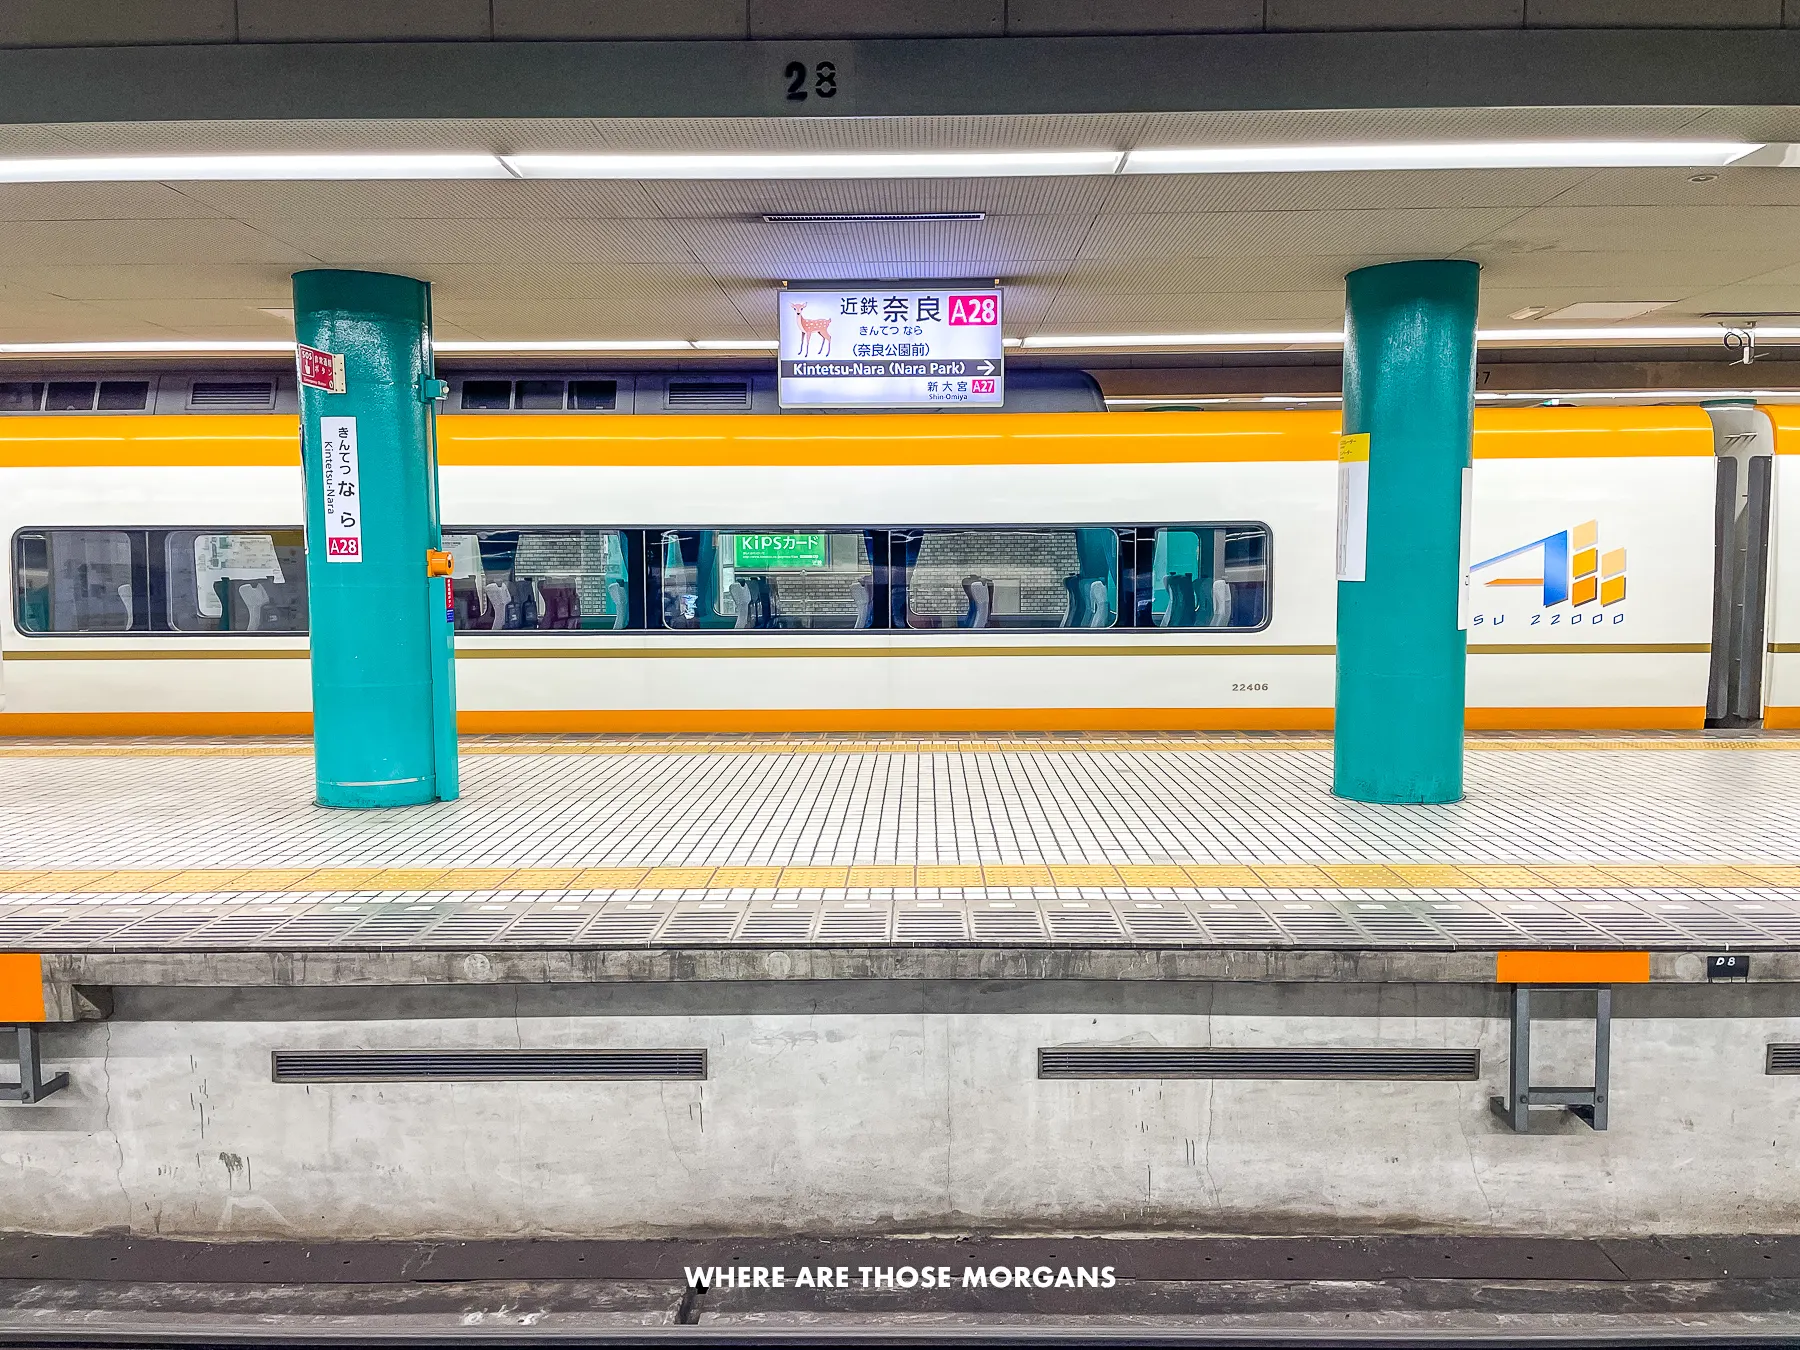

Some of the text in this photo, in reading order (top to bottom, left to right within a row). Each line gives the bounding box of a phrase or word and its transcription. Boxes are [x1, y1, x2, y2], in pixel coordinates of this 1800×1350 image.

[785, 61, 837, 101] 28
[840, 295, 996, 324] 近鉄奈良 A28
[793, 361, 967, 376] Kintetsu-Nara (Nara Park)
[927, 380, 994, 393] 新大宮 A27
[928, 393, 968, 401] Shin-Omiya
[324, 440, 335, 515] Kintetsu-Nara
[330, 538, 358, 556] A28
[1473, 613, 1625, 626] SU 22000
[1231, 683, 1269, 692] 22406
